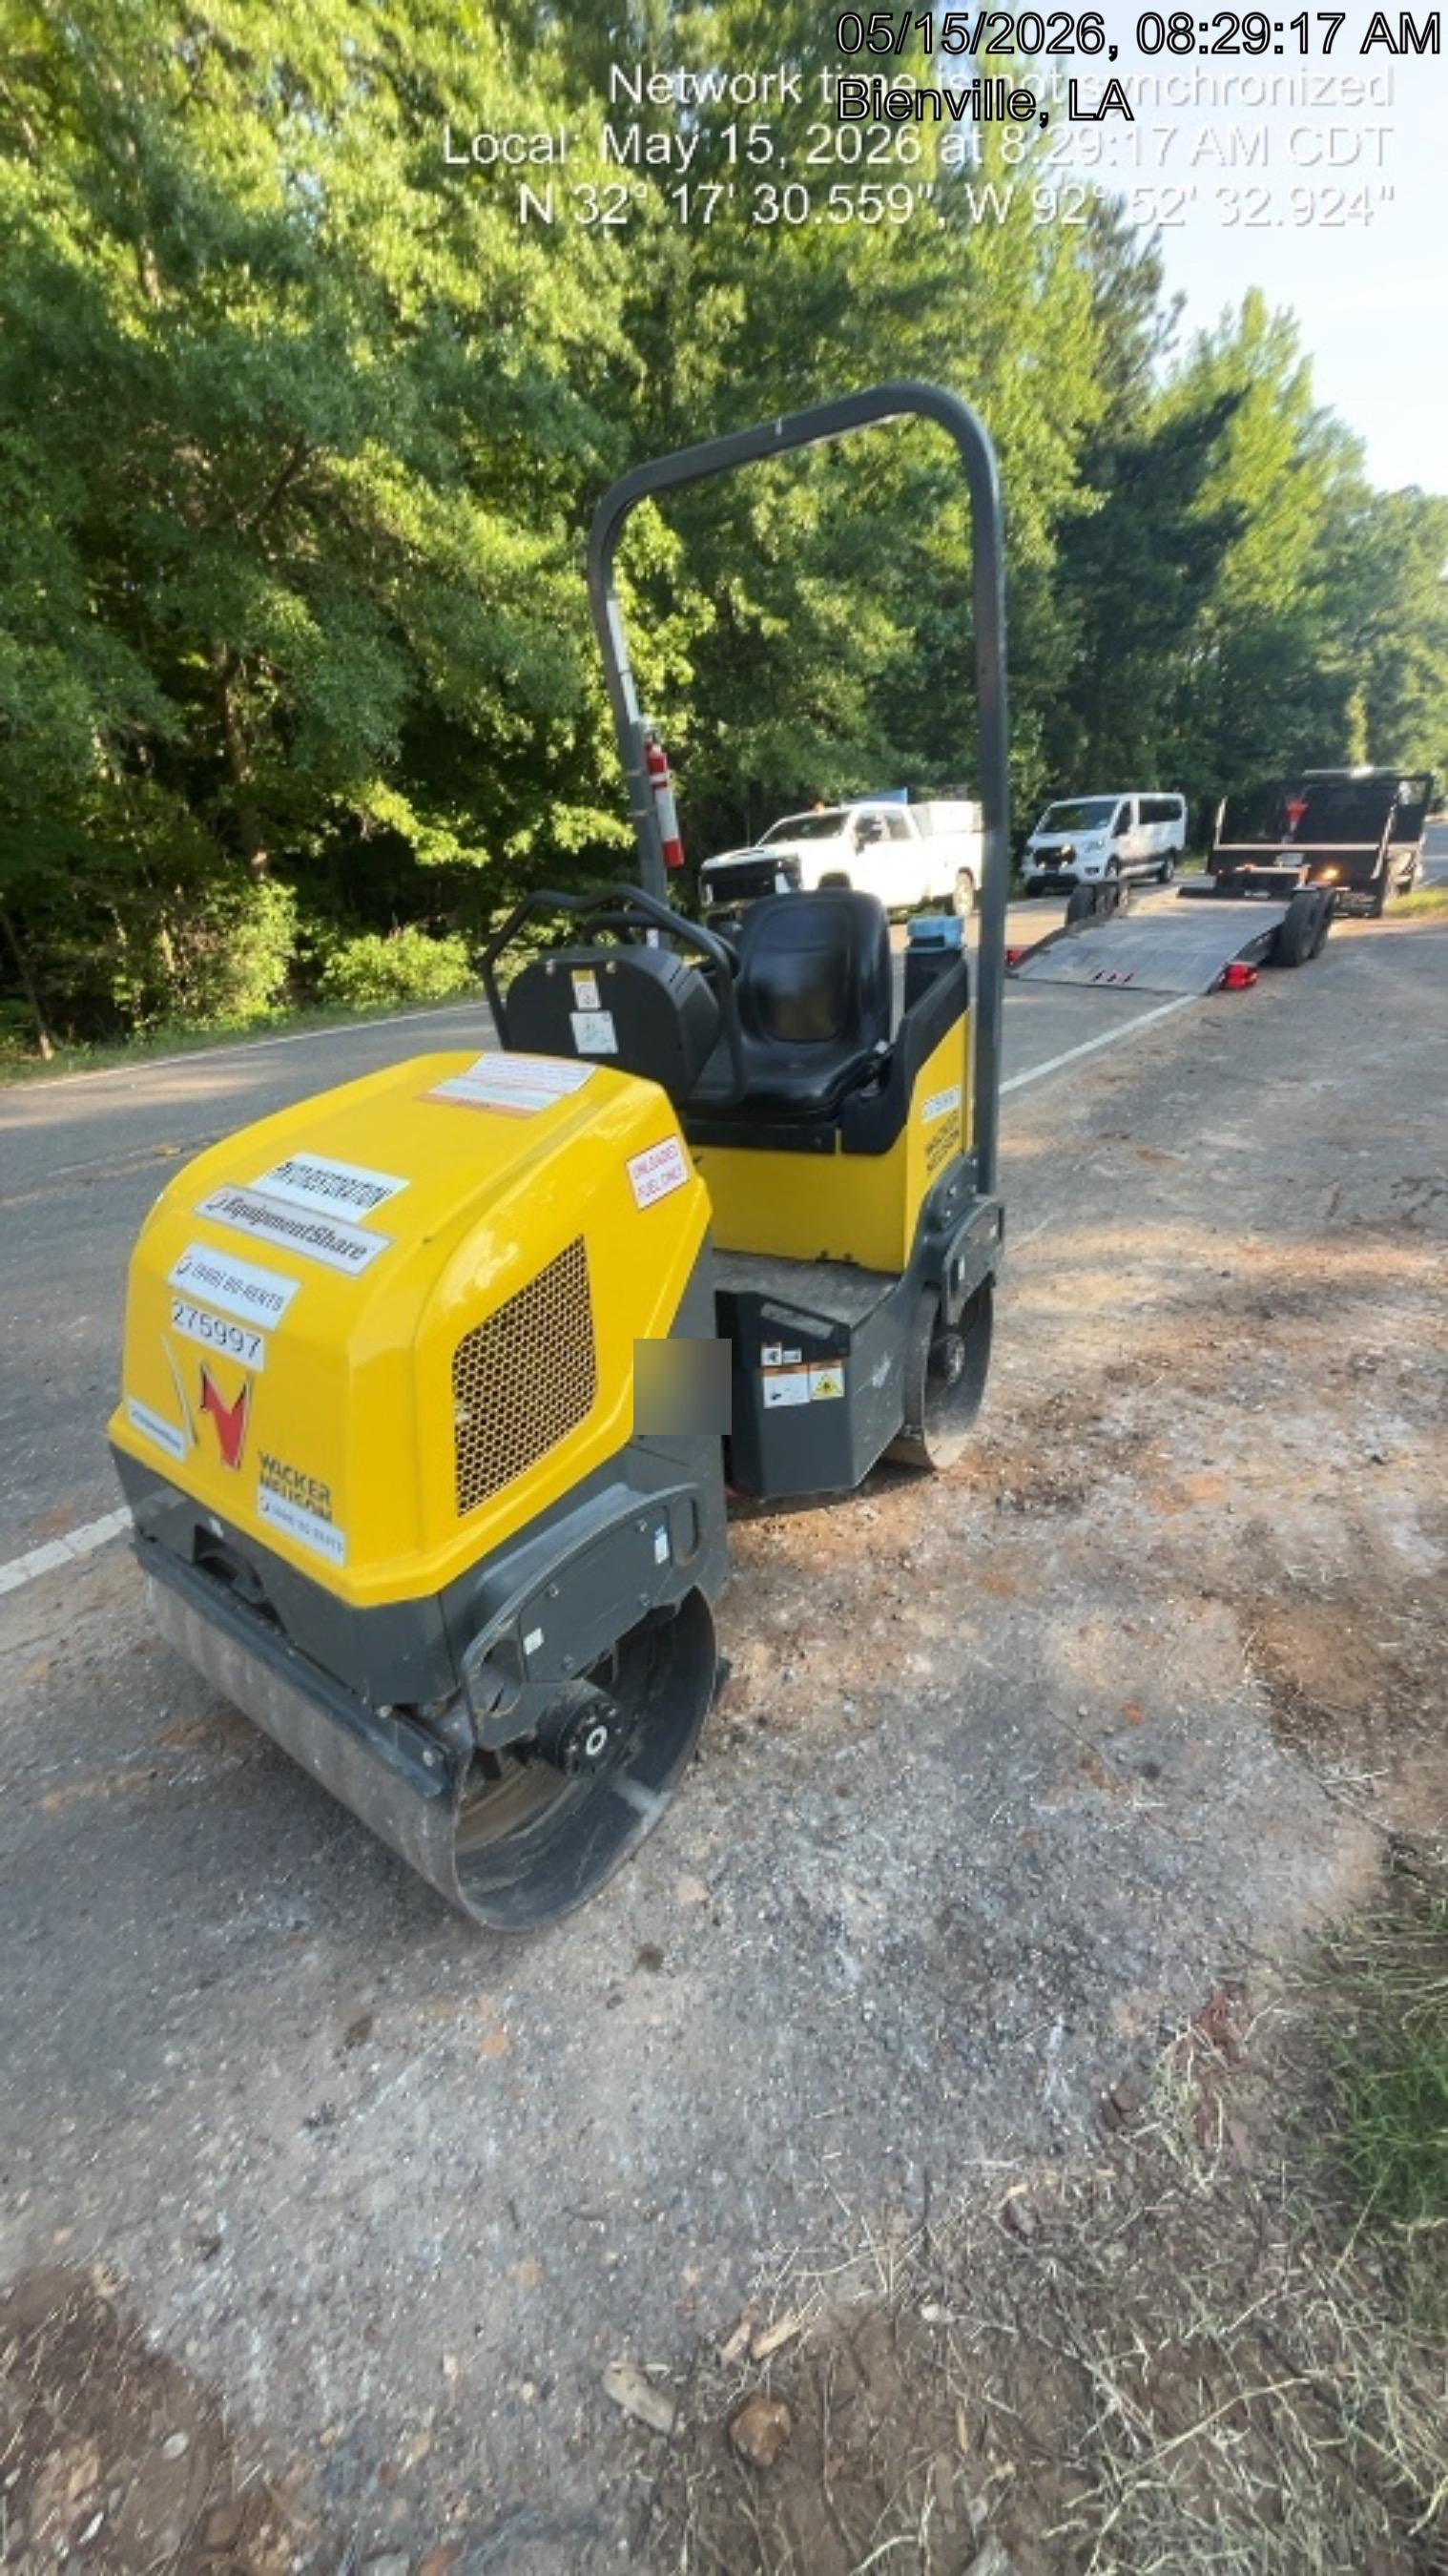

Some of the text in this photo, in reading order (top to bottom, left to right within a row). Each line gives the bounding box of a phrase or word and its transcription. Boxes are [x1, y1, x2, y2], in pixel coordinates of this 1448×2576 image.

[221, 1197, 367, 1260] EquipmentShare
[173, 1298, 262, 1360] 275997
[257, 1448, 331, 1507] WACKER
